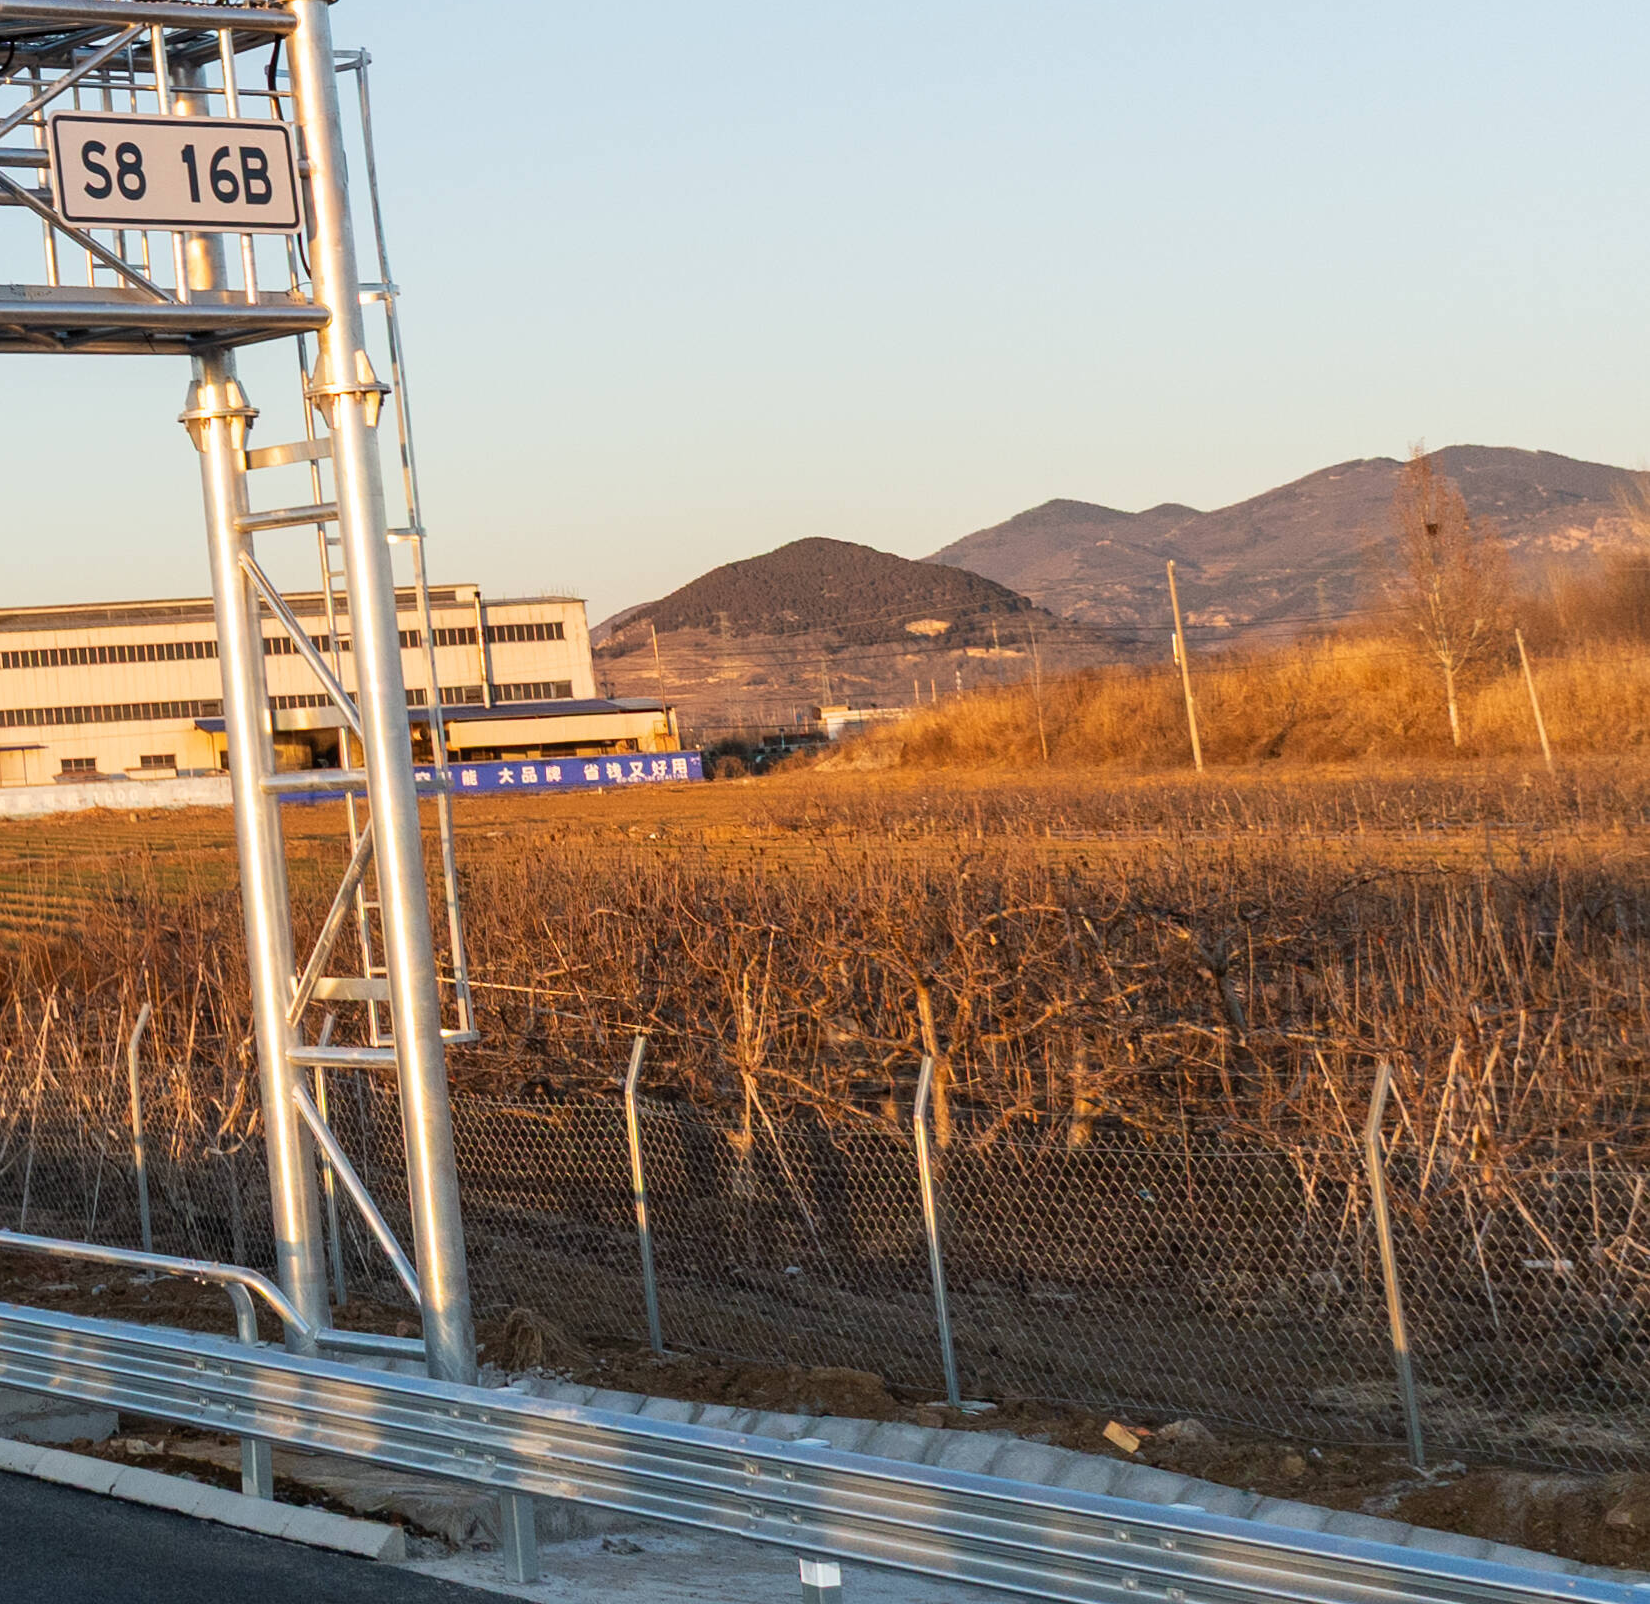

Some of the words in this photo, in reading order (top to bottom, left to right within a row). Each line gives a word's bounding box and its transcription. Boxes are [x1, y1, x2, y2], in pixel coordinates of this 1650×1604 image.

[81, 139, 147, 201] S8
[180, 143, 273, 205] 16B
[497, 765, 562, 785] 大品牌
